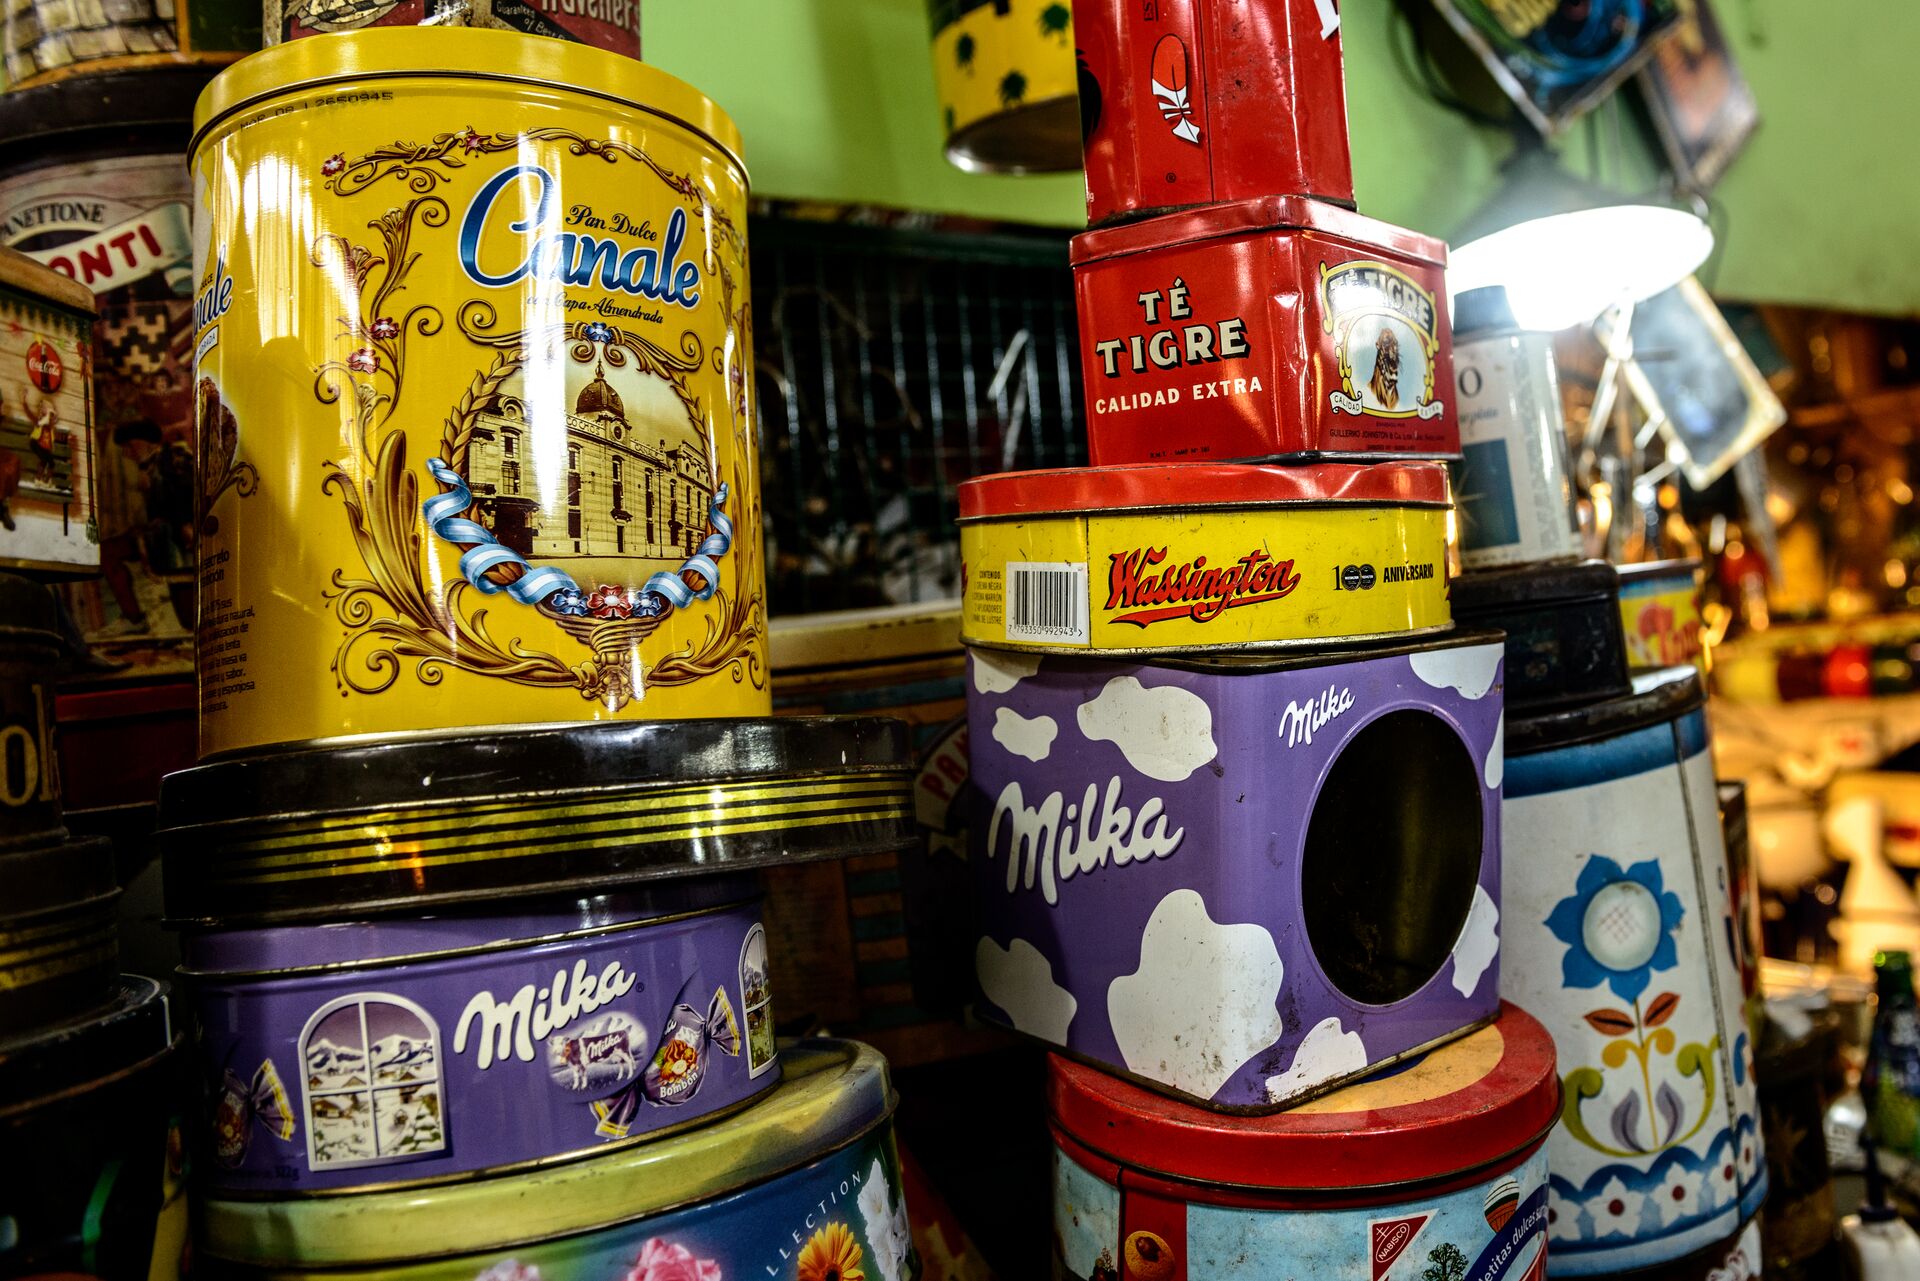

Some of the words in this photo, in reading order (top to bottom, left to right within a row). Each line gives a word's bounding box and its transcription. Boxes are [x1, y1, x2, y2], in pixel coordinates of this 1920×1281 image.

[0, 203, 106, 239] ANETTONE
[457, 164, 701, 310] Canale
[565, 204, 606, 230] Pan
[609, 212, 658, 242] Dulce
[586, 295, 664, 325] Almendrada
[1138, 276, 1194, 326] TÉ
[1095, 317, 1252, 379] TIGRE
[1095, 388, 1181, 415] CALIDAD
[1192, 376, 1263, 400] EXTRA
[1334, 394, 1360, 412] CALIDAD
[1103, 546, 1301, 628] Wassington
[1383, 563, 1434, 583] ANIVERSARIO
[1278, 684, 1356, 749] Milka
[987, 774, 1185, 906] Milka
[453, 958, 637, 1071] Milka
[586, 1033, 623, 1061] Milka
[659, 1071, 699, 1099] Bombón
[765, 1170, 862, 1278] LLECTION
[1377, 1225, 1408, 1261] NABISCO
